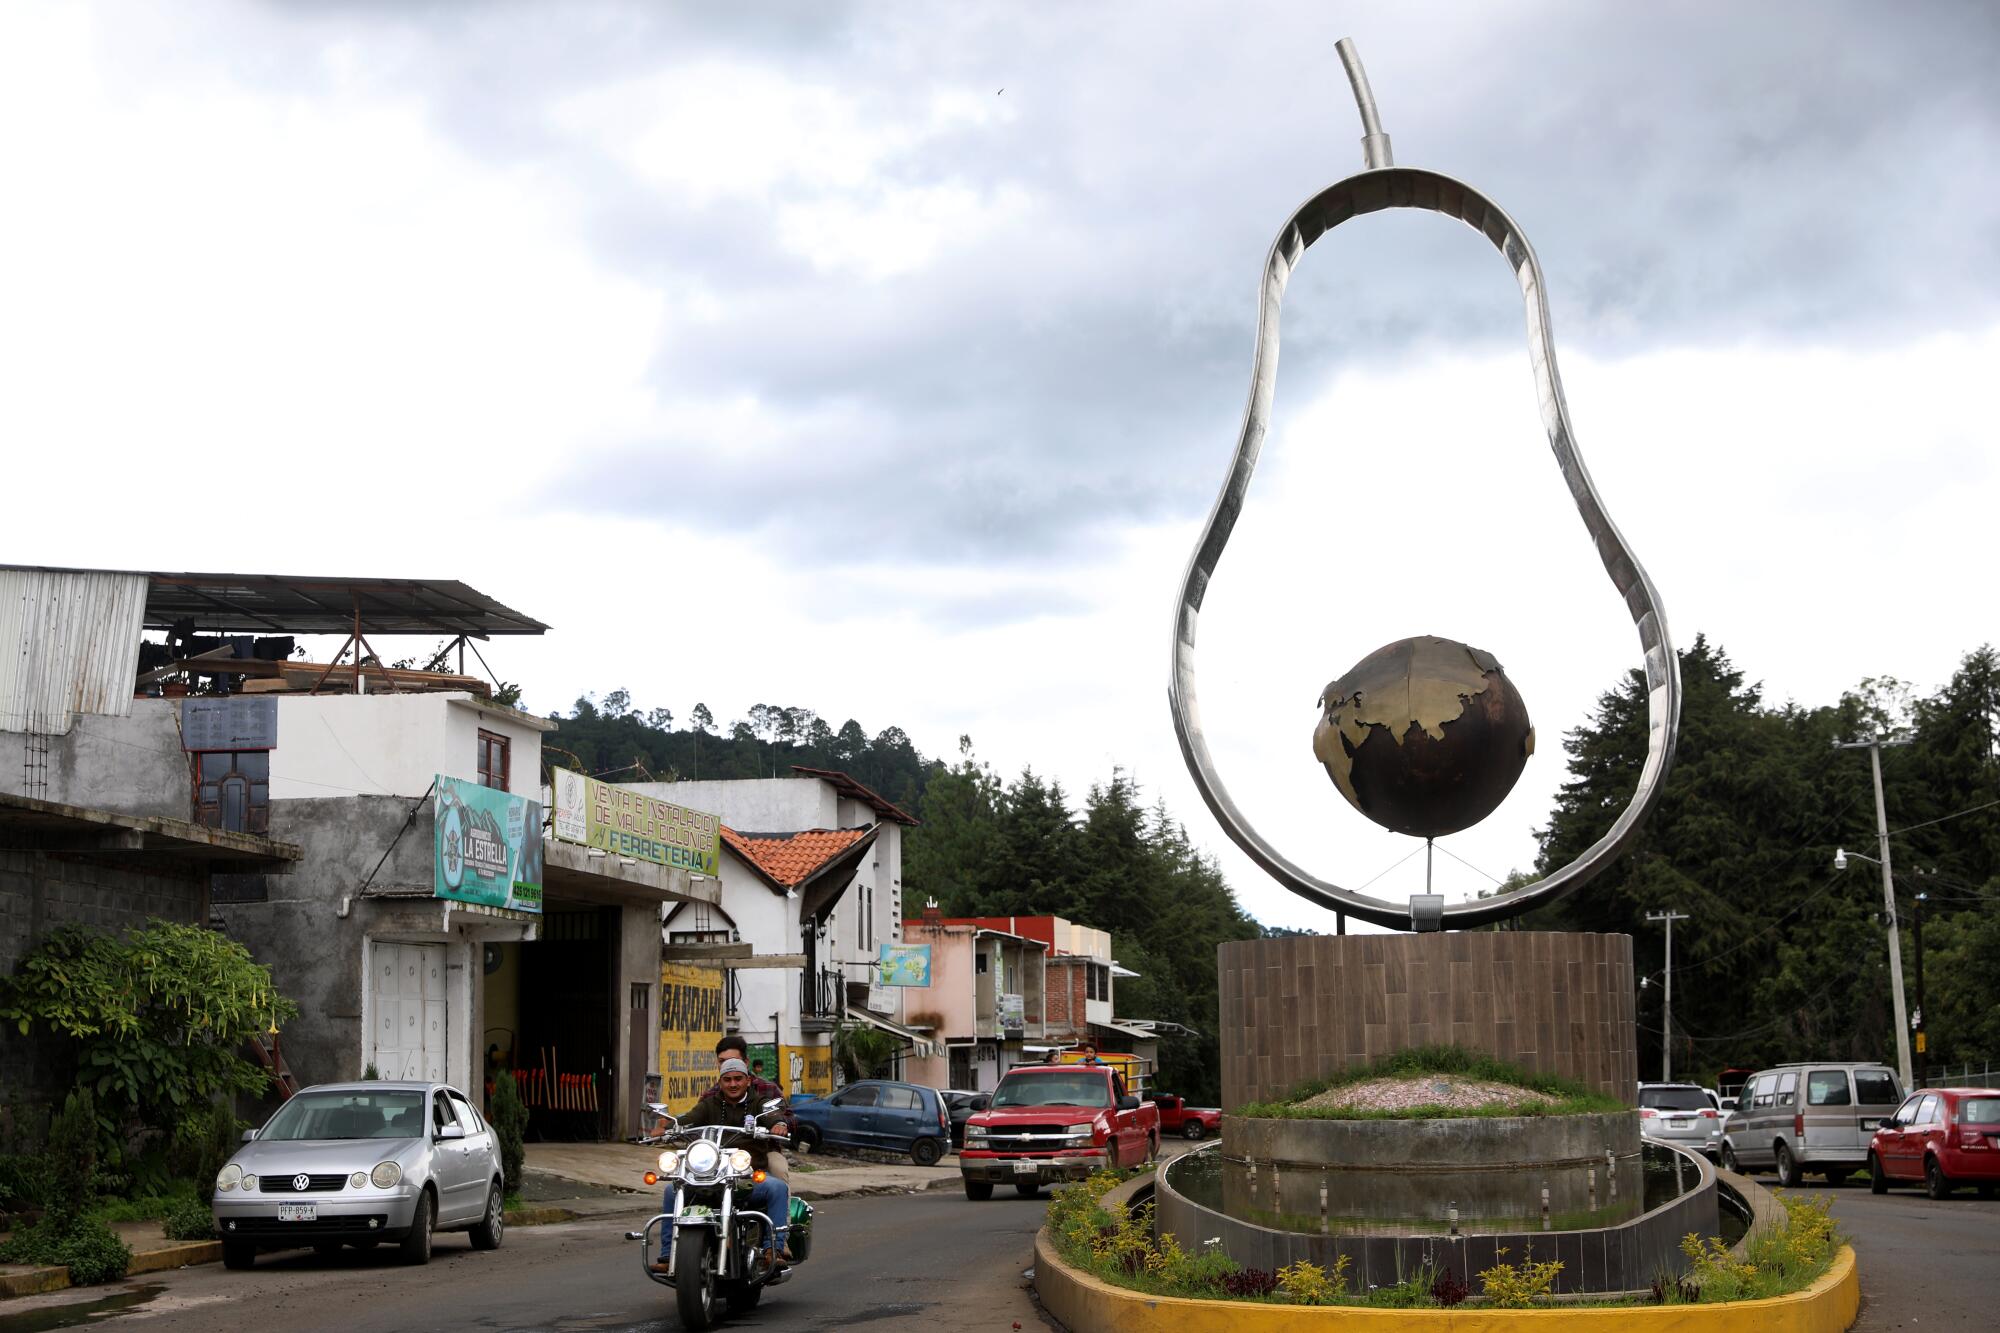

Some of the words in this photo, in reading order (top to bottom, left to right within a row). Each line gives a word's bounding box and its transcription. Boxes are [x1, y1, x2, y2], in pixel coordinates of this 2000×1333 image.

[591, 782, 630, 811] VENTA
[635, 795, 643, 815] E
[648, 800, 718, 834] INSTALACION
[595, 804, 611, 826] DE
[615, 811, 654, 836] MALLA
[659, 824, 713, 853] CICLONICA
[464, 836, 474, 859] LA
[475, 839, 507, 866] ESTRELLA
[609, 829, 704, 870] FERRETERIA
[661, 983, 723, 1032] BARDAHL
[789, 1051, 804, 1080] TOP
